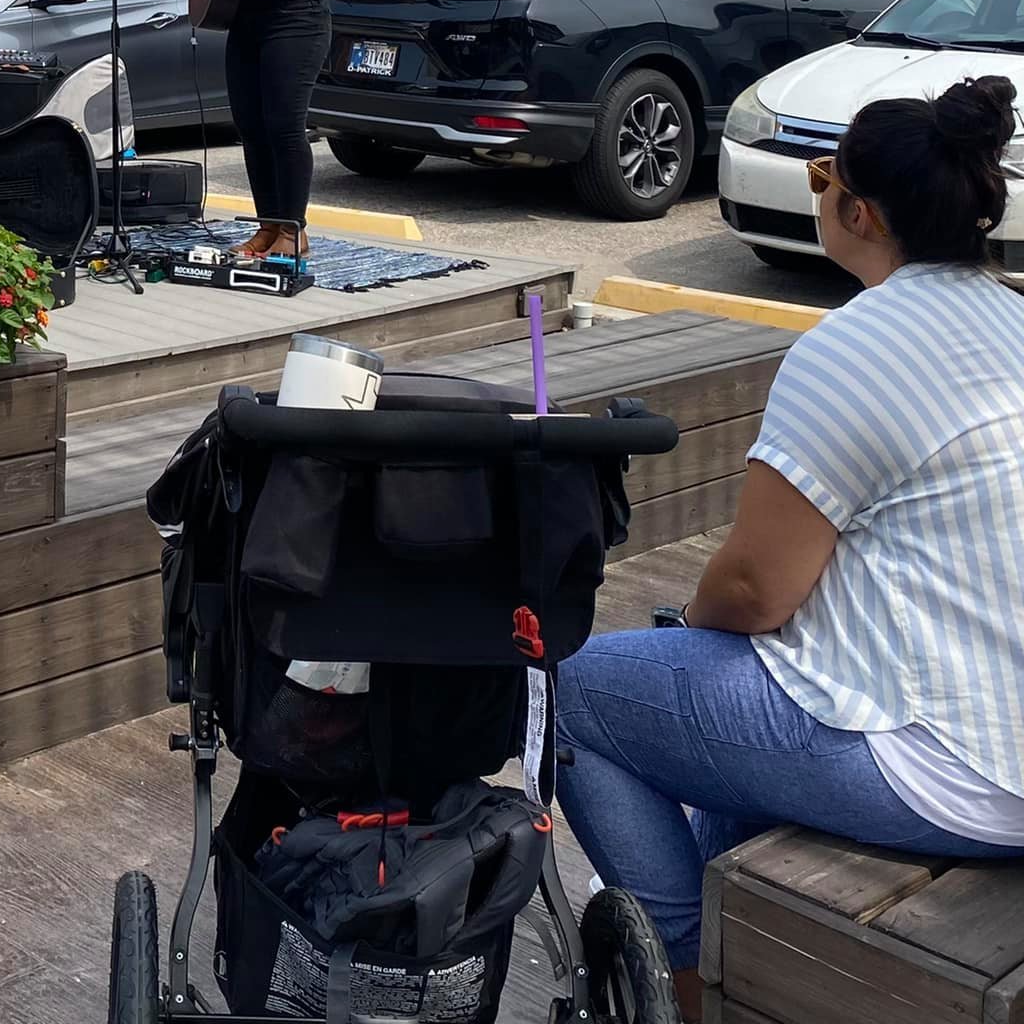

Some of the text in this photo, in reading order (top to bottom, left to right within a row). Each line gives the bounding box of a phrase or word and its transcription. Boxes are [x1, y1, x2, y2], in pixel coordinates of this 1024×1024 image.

[536, 698, 545, 737] WARNING
[372, 964, 383, 973] EN
[383, 967, 407, 975] GARDE
